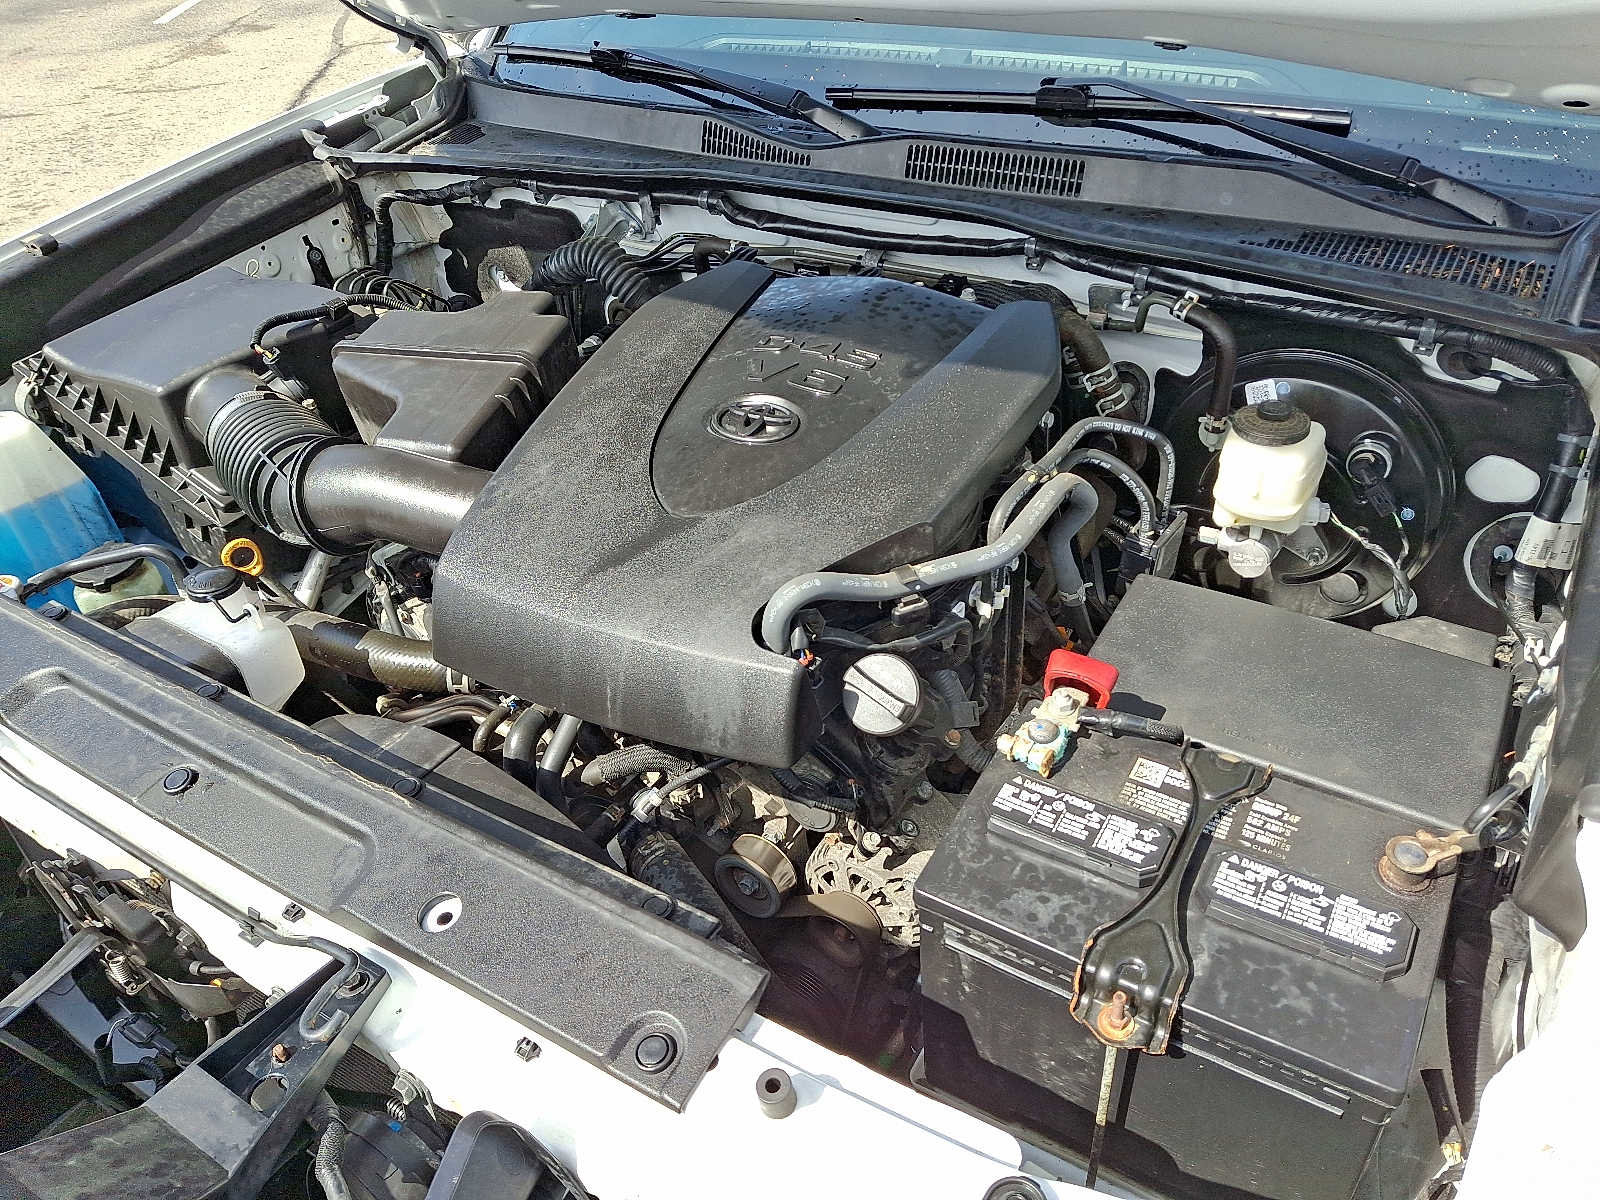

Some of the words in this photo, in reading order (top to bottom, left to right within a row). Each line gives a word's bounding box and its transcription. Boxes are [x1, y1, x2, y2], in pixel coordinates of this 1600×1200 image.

[748, 360, 849, 396] V6
[1023, 779, 1058, 798] DANGER
[1063, 793, 1096, 812] POISON
[1255, 833, 1292, 852] MINUTES
[1264, 822, 1291, 837] AMPS
[1240, 858, 1280, 879] DANGER
[1287, 874, 1325, 895] POISON
